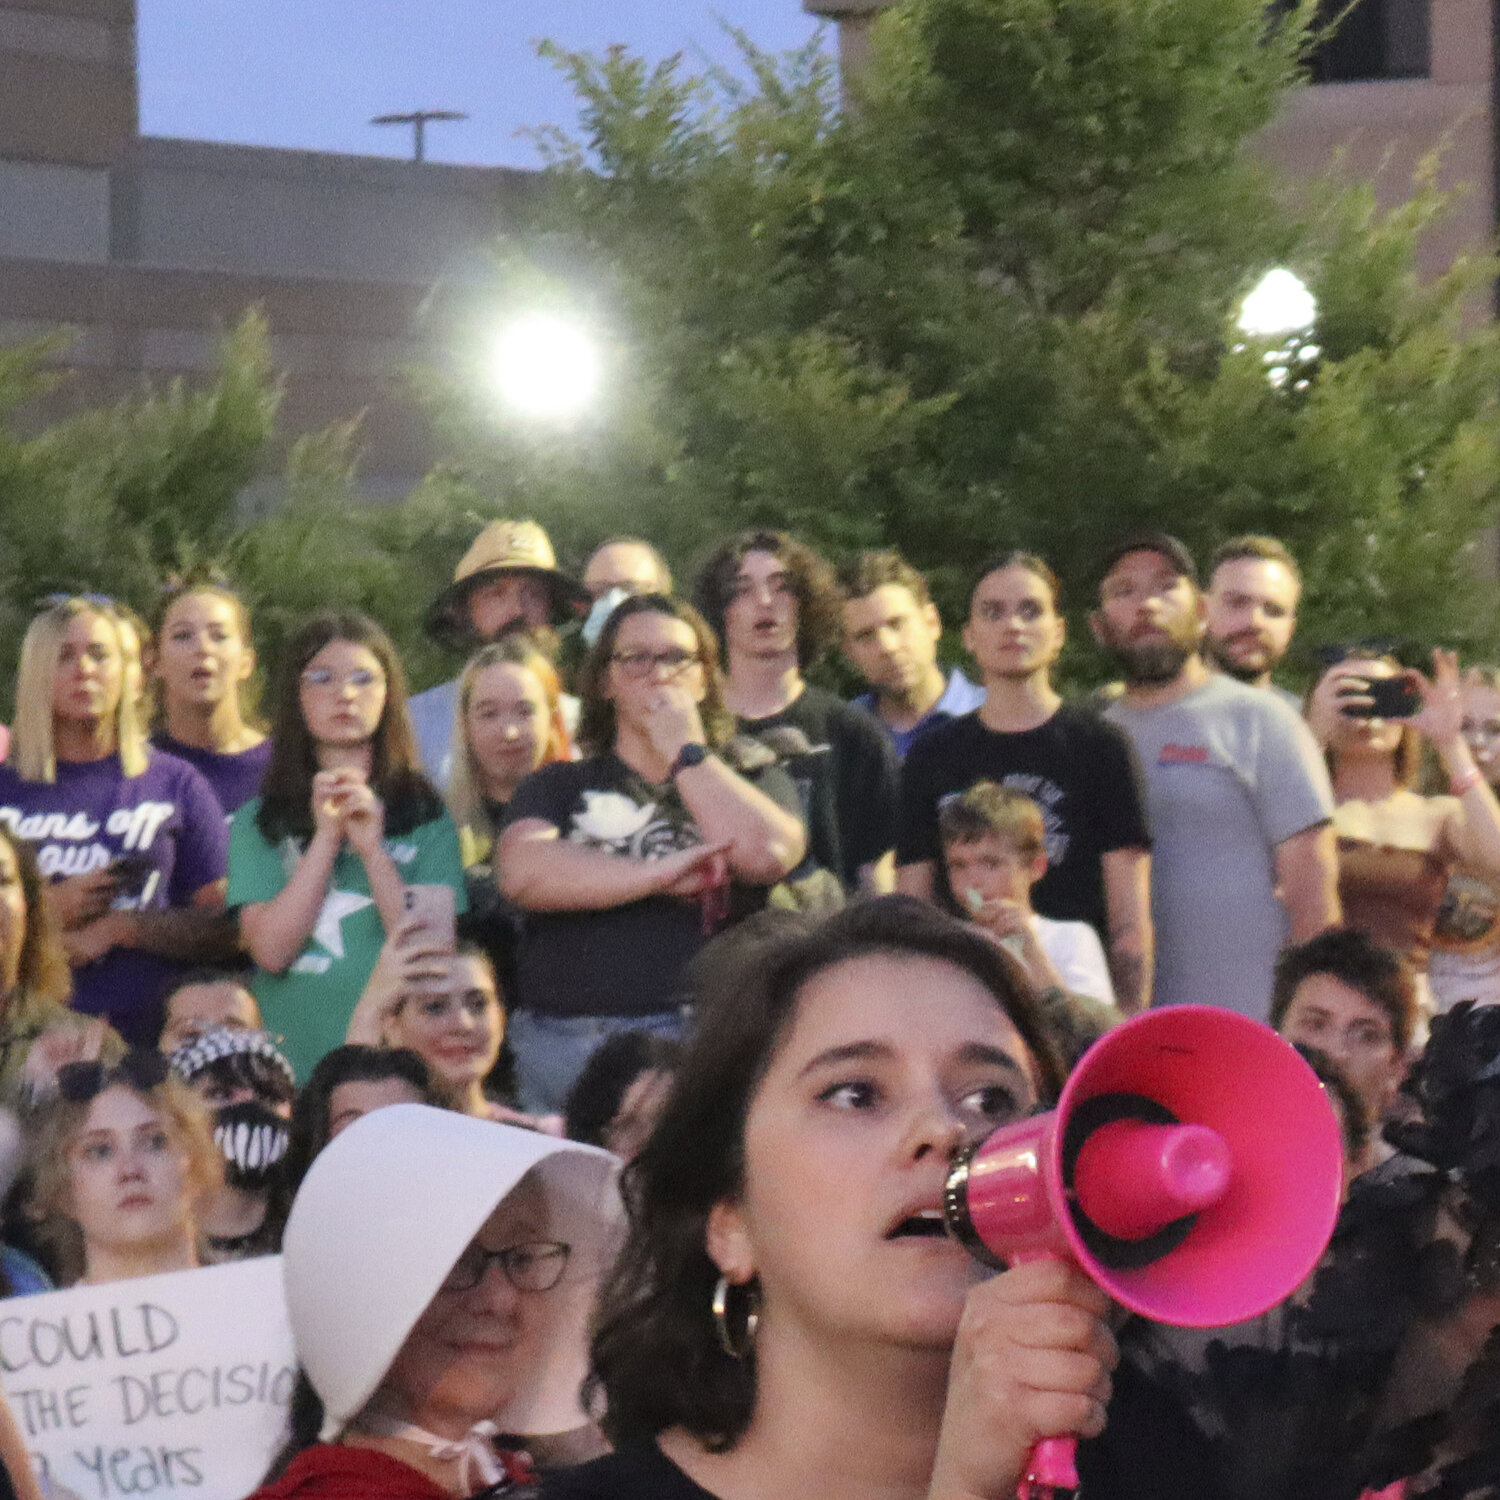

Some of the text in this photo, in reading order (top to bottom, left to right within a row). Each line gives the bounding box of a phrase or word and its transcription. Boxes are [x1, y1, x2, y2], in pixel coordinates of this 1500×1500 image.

[105, 801, 175, 850] off
[0, 1303, 179, 1373] COULD
[10, 1385, 92, 1436] THE
